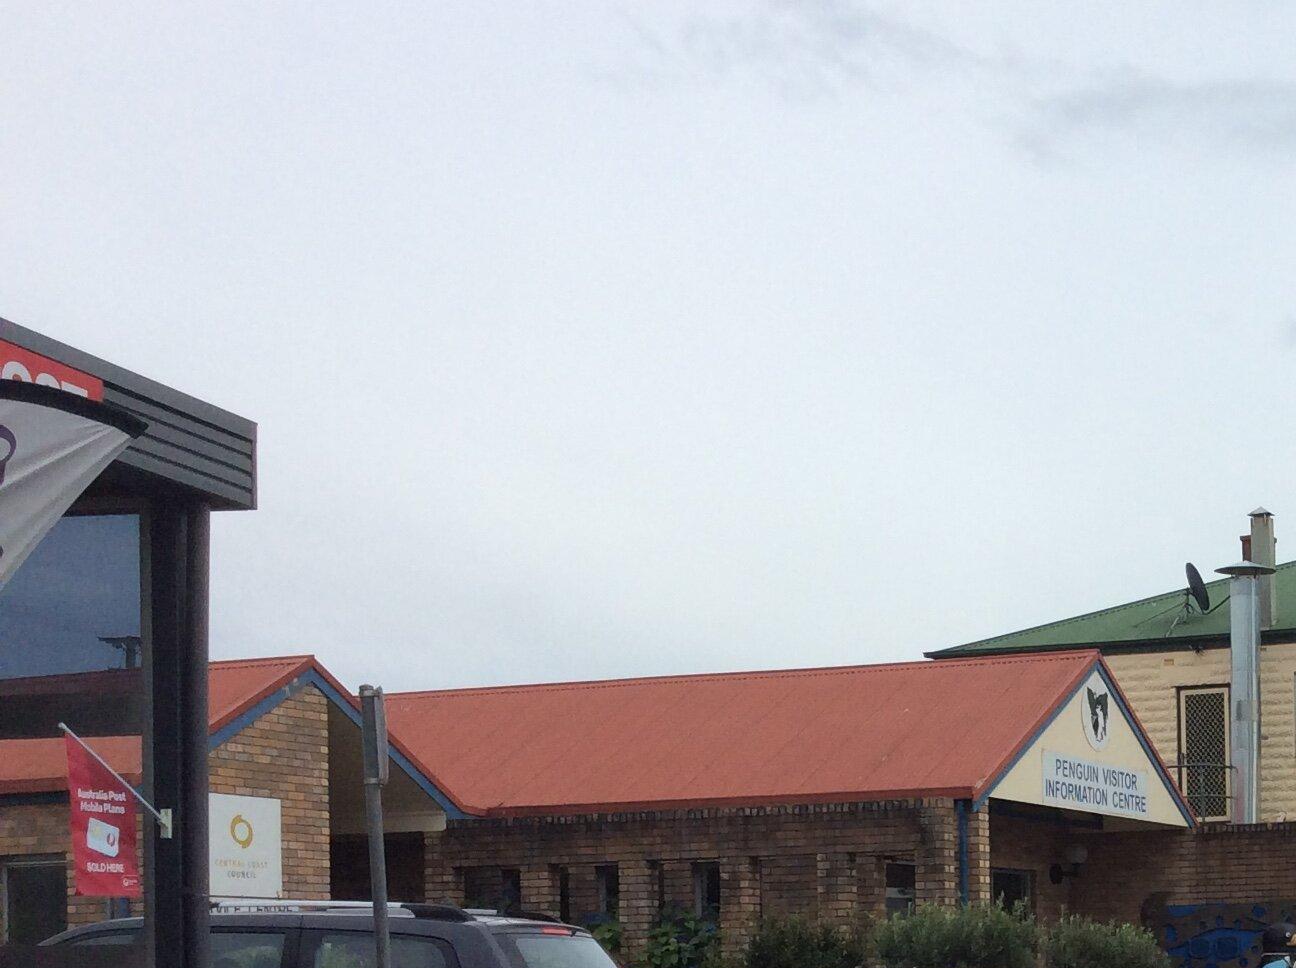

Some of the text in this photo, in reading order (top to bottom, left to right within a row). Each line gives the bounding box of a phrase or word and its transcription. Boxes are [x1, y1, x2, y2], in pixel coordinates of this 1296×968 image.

[1055, 759, 1138, 790] PENGUIN VISITOR
[1045, 779, 1146, 813] INFORMATION CENTRE
[86, 862, 124, 873] SOLD HERE
